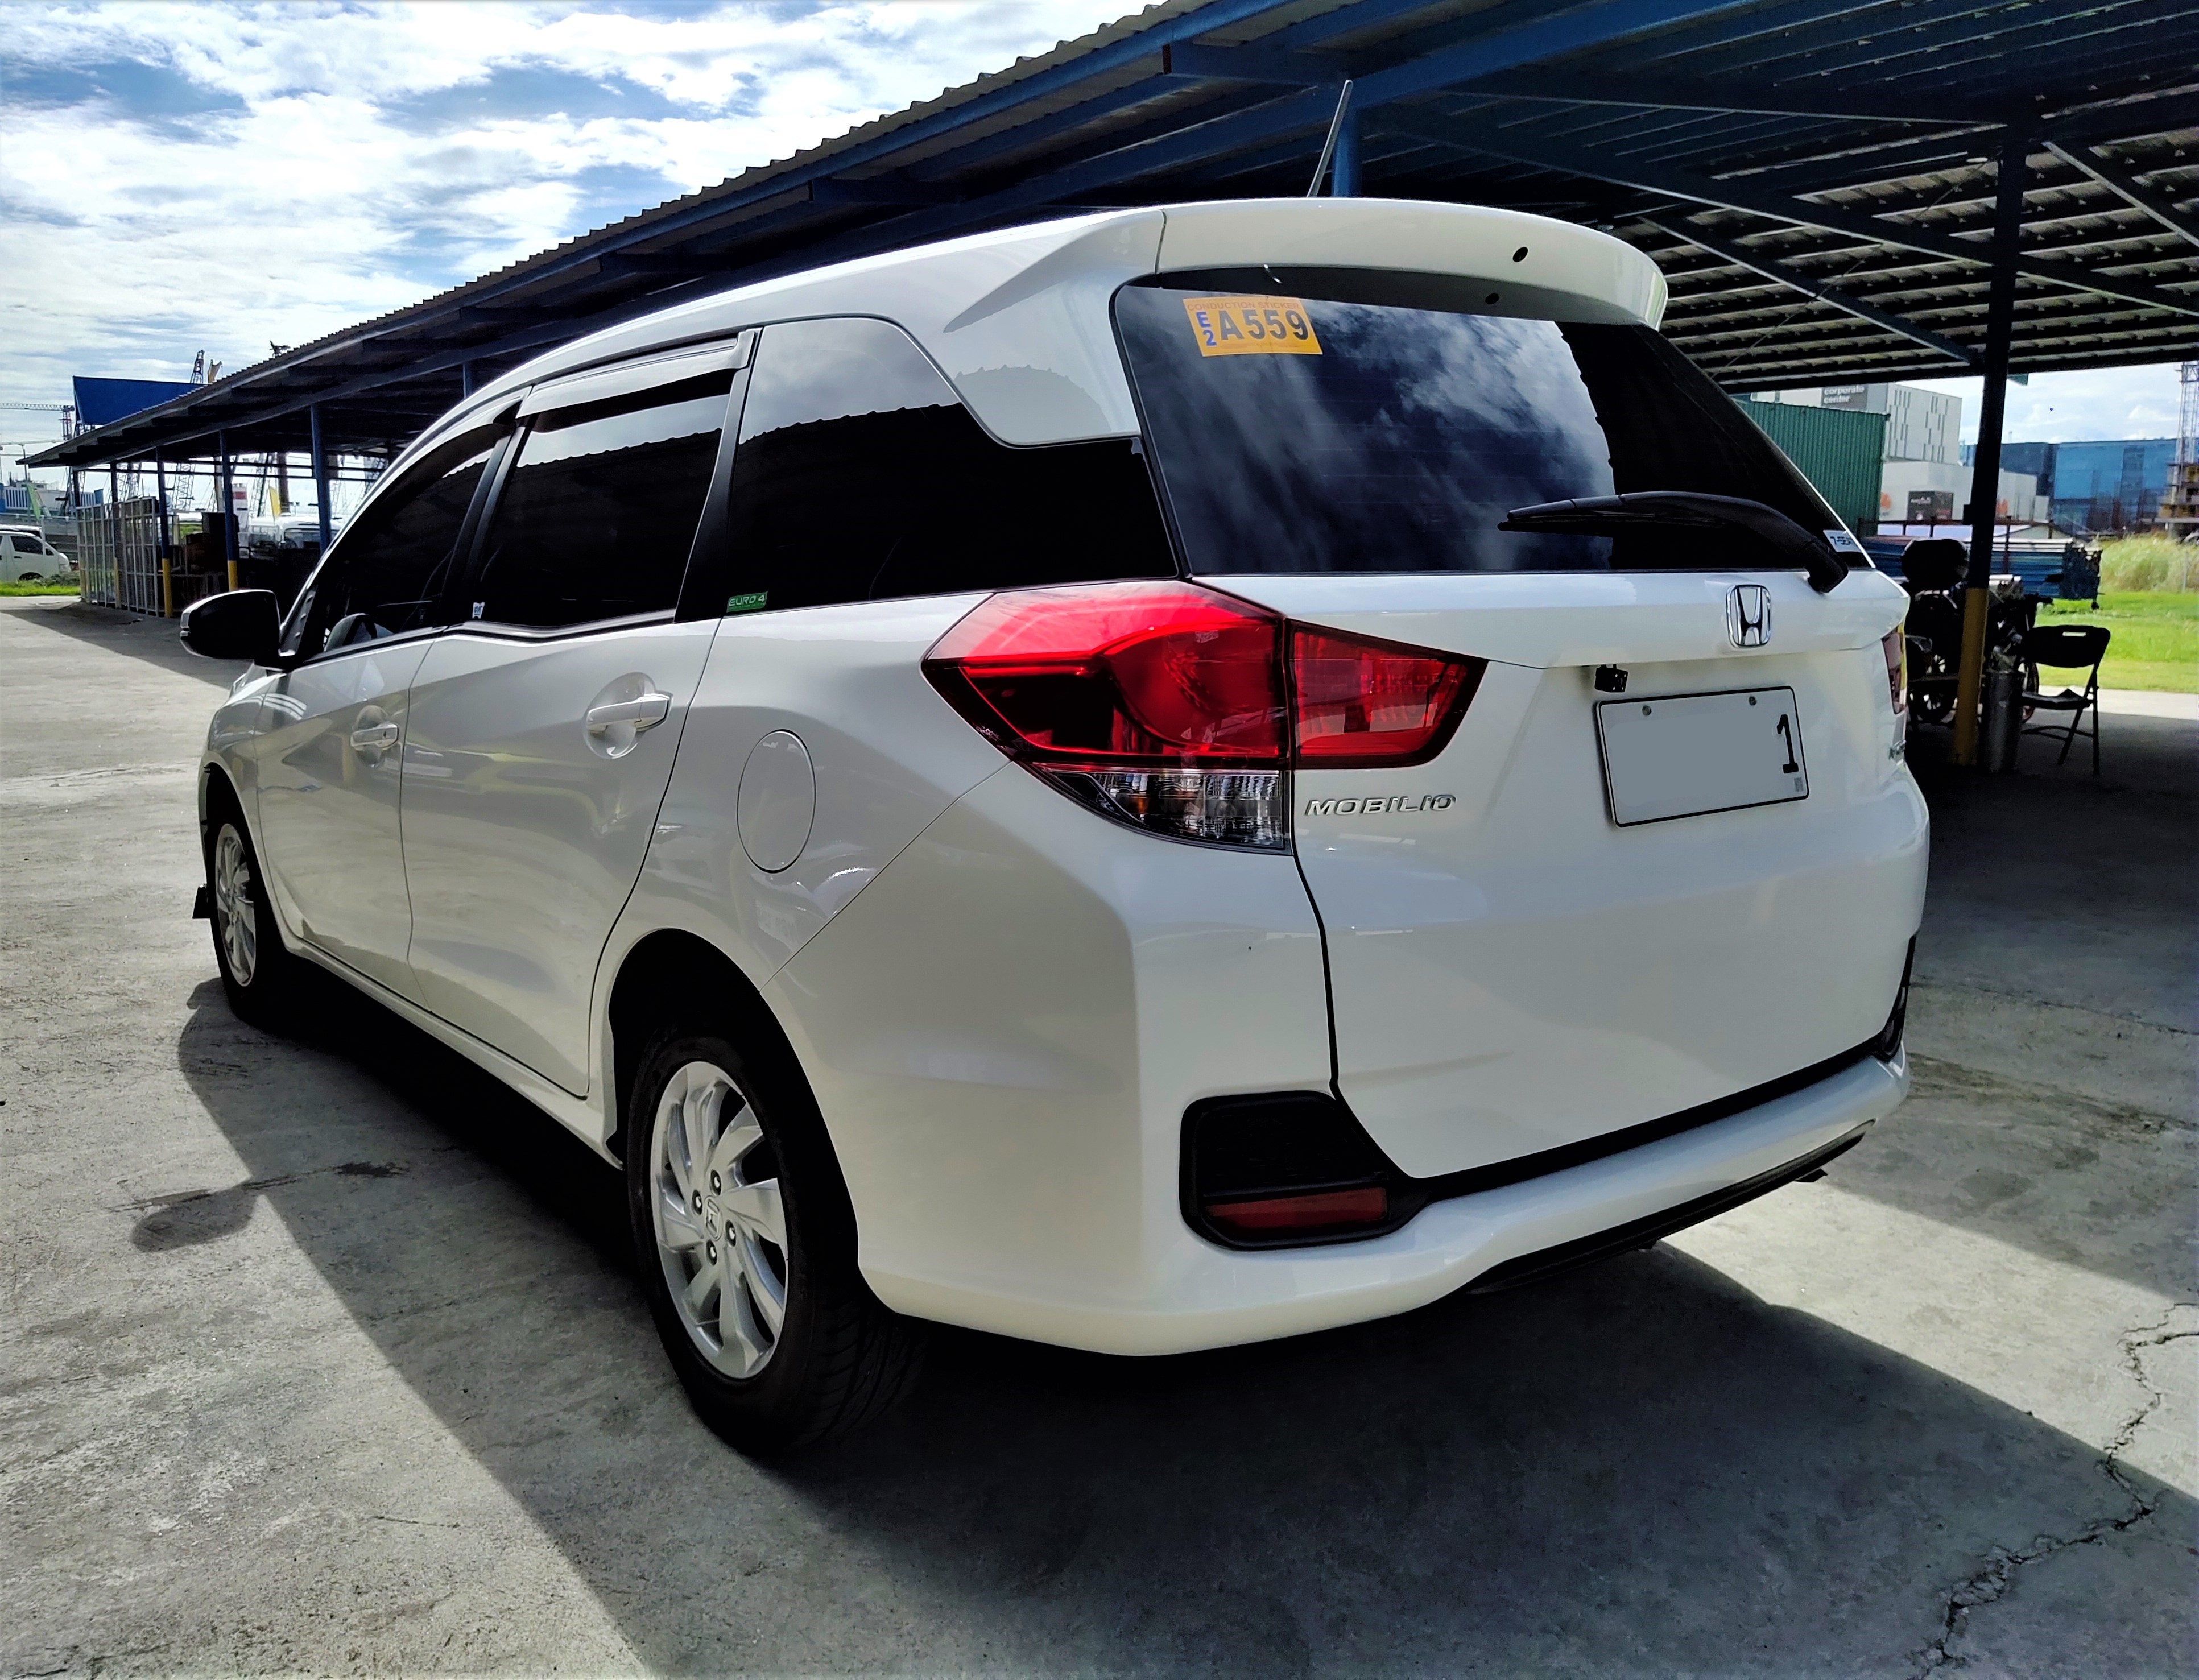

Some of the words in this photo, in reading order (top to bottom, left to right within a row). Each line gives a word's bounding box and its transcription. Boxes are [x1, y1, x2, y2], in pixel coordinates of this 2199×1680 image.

[1187, 301, 1255, 311] CONDUCTION
[1218, 309, 1309, 341] A559
[1824, 386, 1865, 395] corporate
[729, 595, 757, 606] EURO
[1304, 794, 1456, 816] MOBILIO
